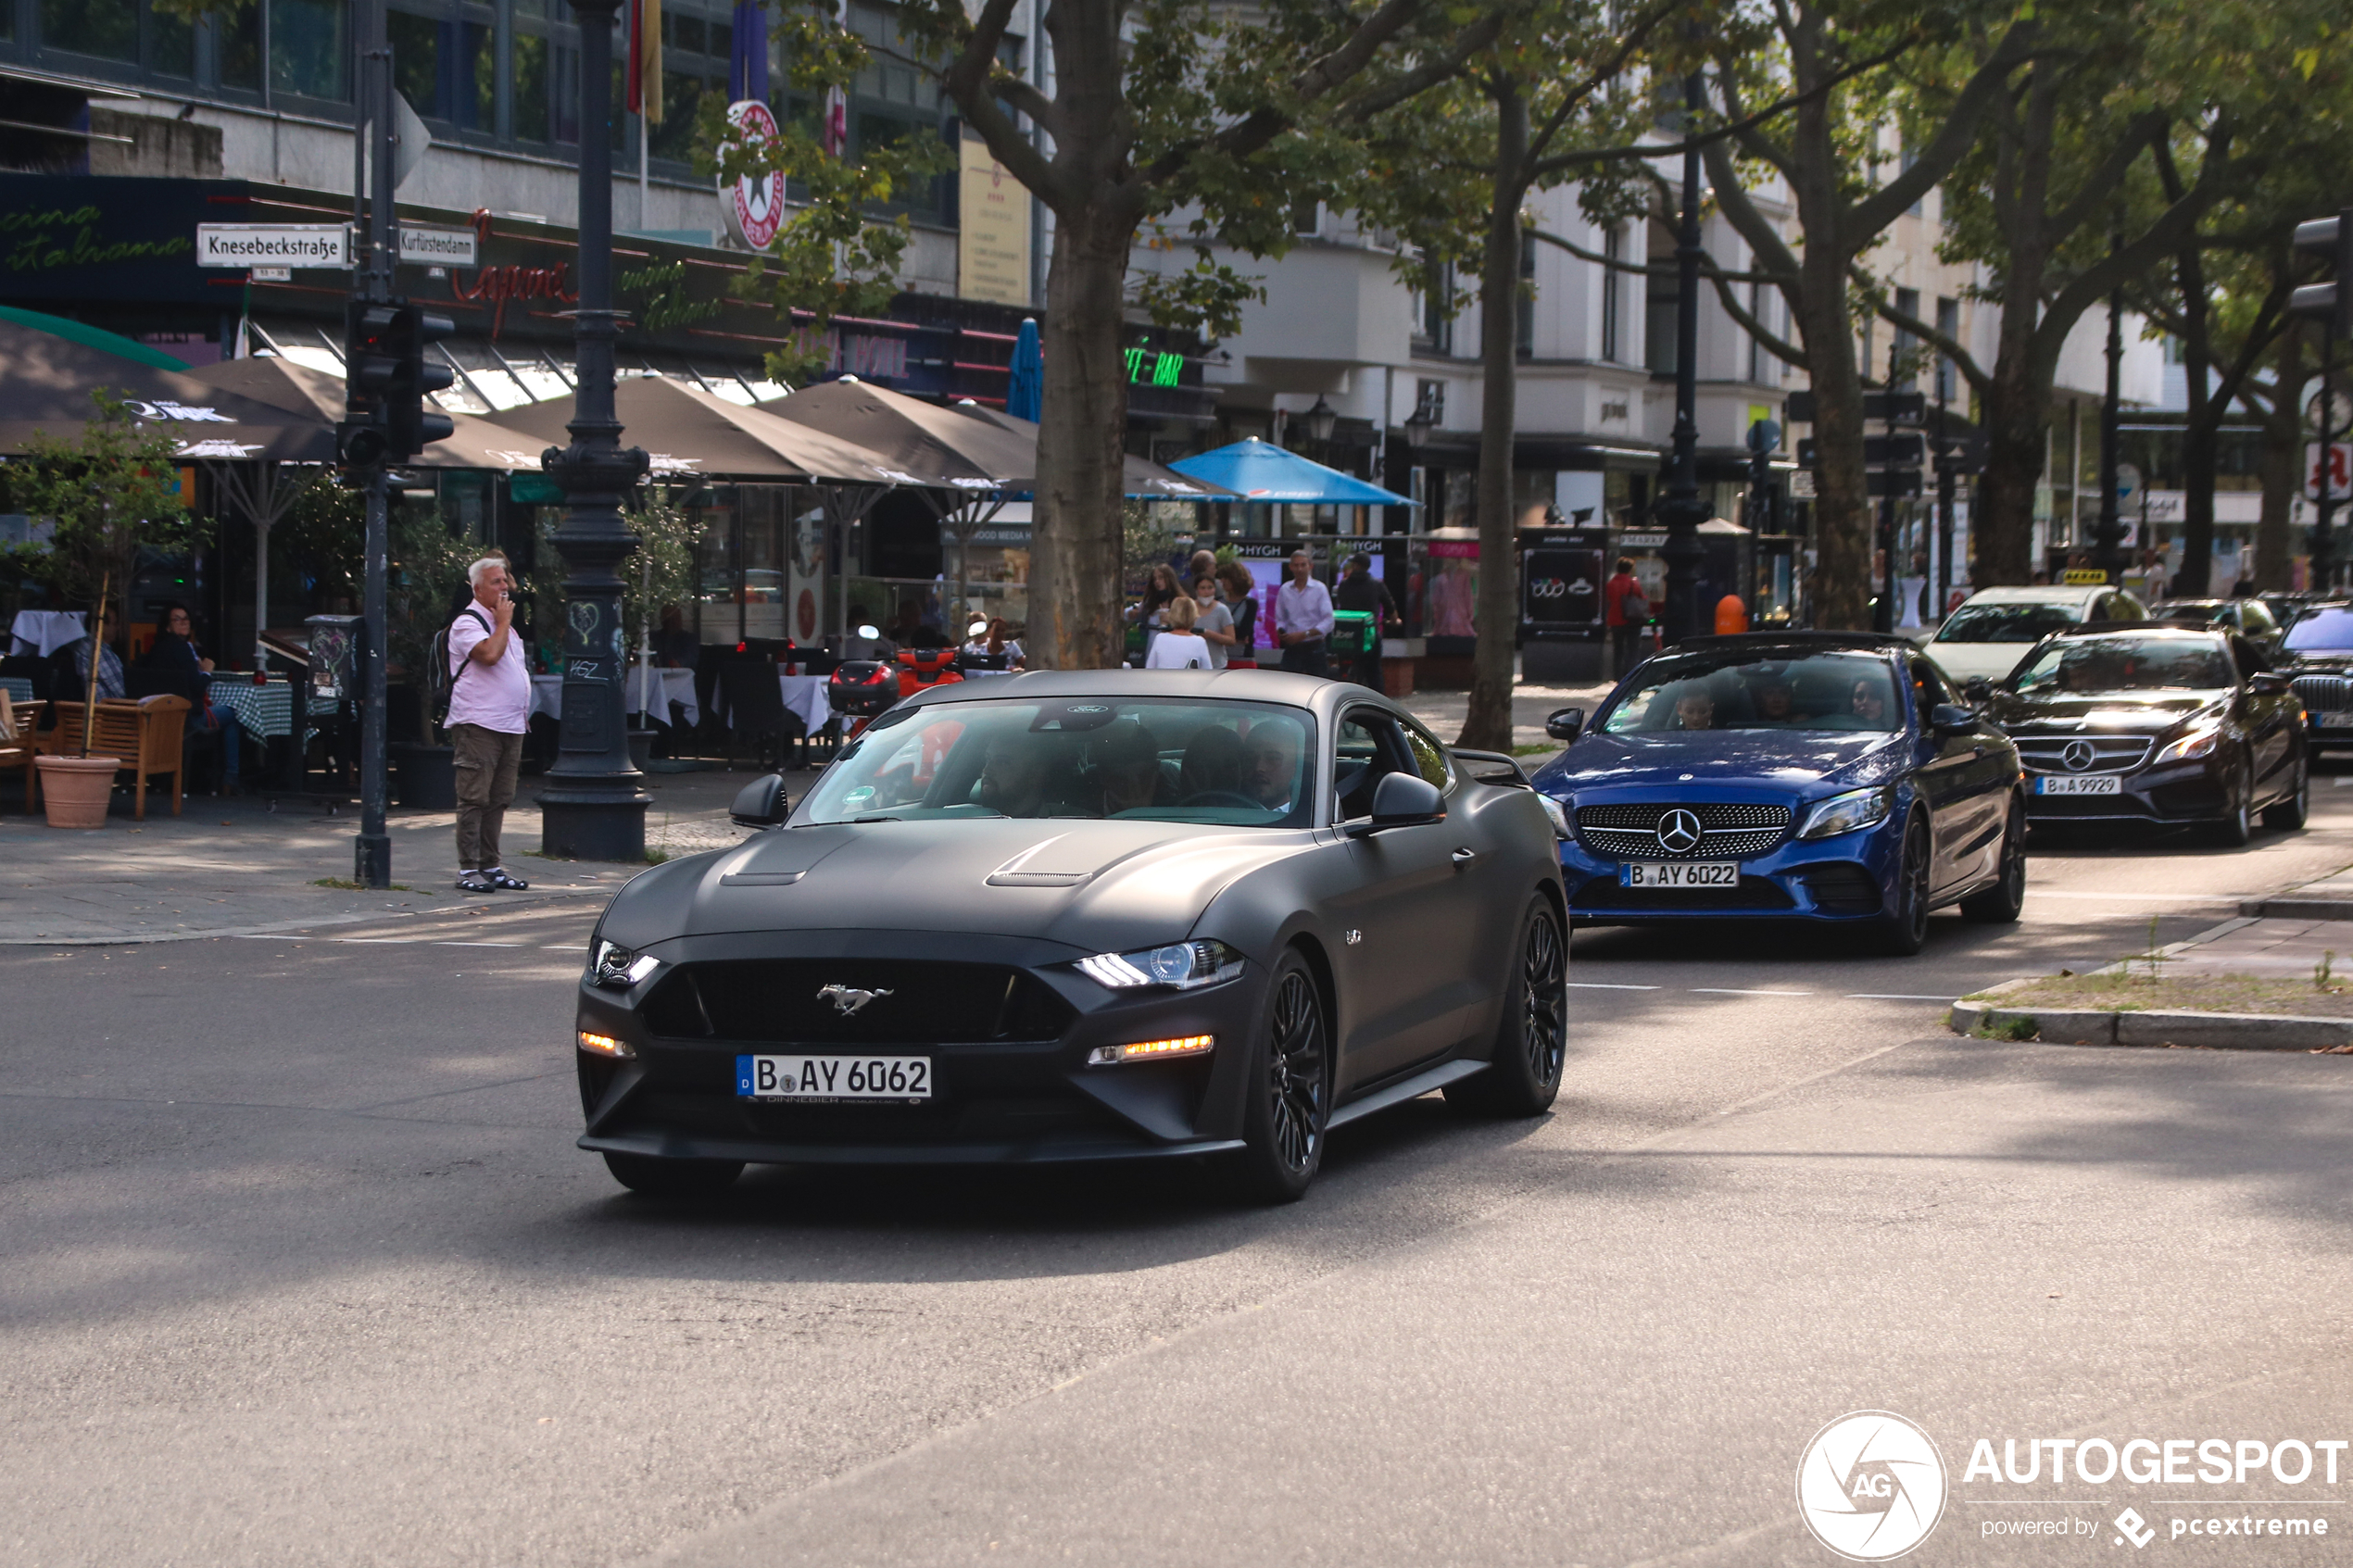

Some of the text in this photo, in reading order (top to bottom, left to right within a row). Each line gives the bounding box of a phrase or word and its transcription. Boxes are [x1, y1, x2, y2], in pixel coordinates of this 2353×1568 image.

[6, 226, 192, 270] italiana
[208, 235, 338, 259] Knesebeckstraße
[401, 232, 472, 255] Kurfürstendamm
[855, 333, 910, 378] HOTEL
[1246, 546, 1281, 555] HYGH
[2079, 779, 2115, 793] 9929
[1632, 866, 1735, 884] B AY 6022
[742, 1079, 749, 1088] D
[758, 1059, 927, 1092] B AY 6062
[767, 1096, 839, 1104] DINNEBIER
